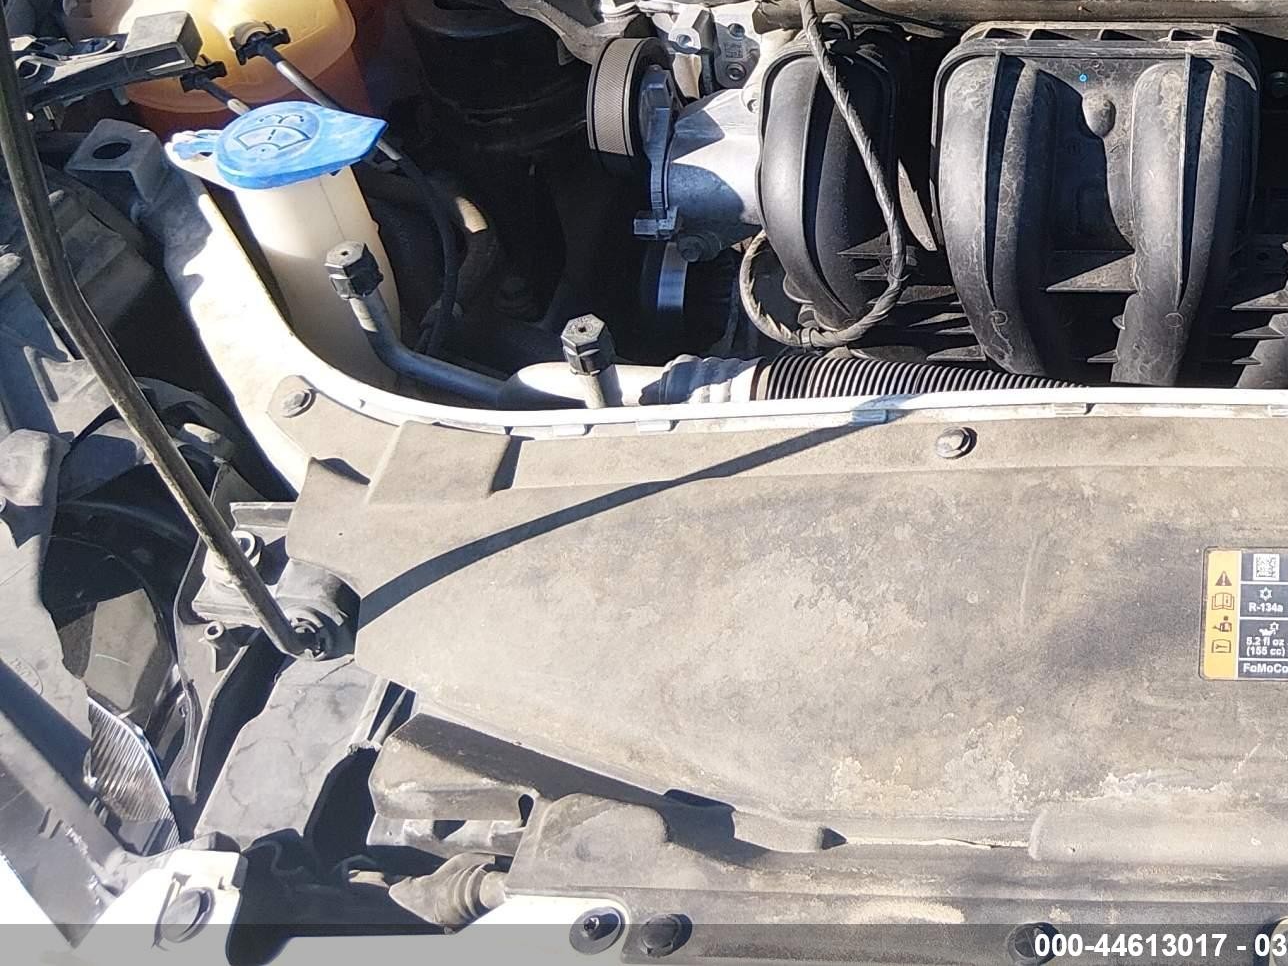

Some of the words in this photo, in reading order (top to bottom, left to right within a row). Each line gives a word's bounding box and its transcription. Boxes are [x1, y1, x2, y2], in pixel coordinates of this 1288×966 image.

[1248, 602, 1284, 612] R-134a
[1263, 636, 1270, 646] fl
[1272, 638, 1285, 646] oz
[1246, 646, 1268, 657] (155
[1270, 647, 1286, 657] cc)
